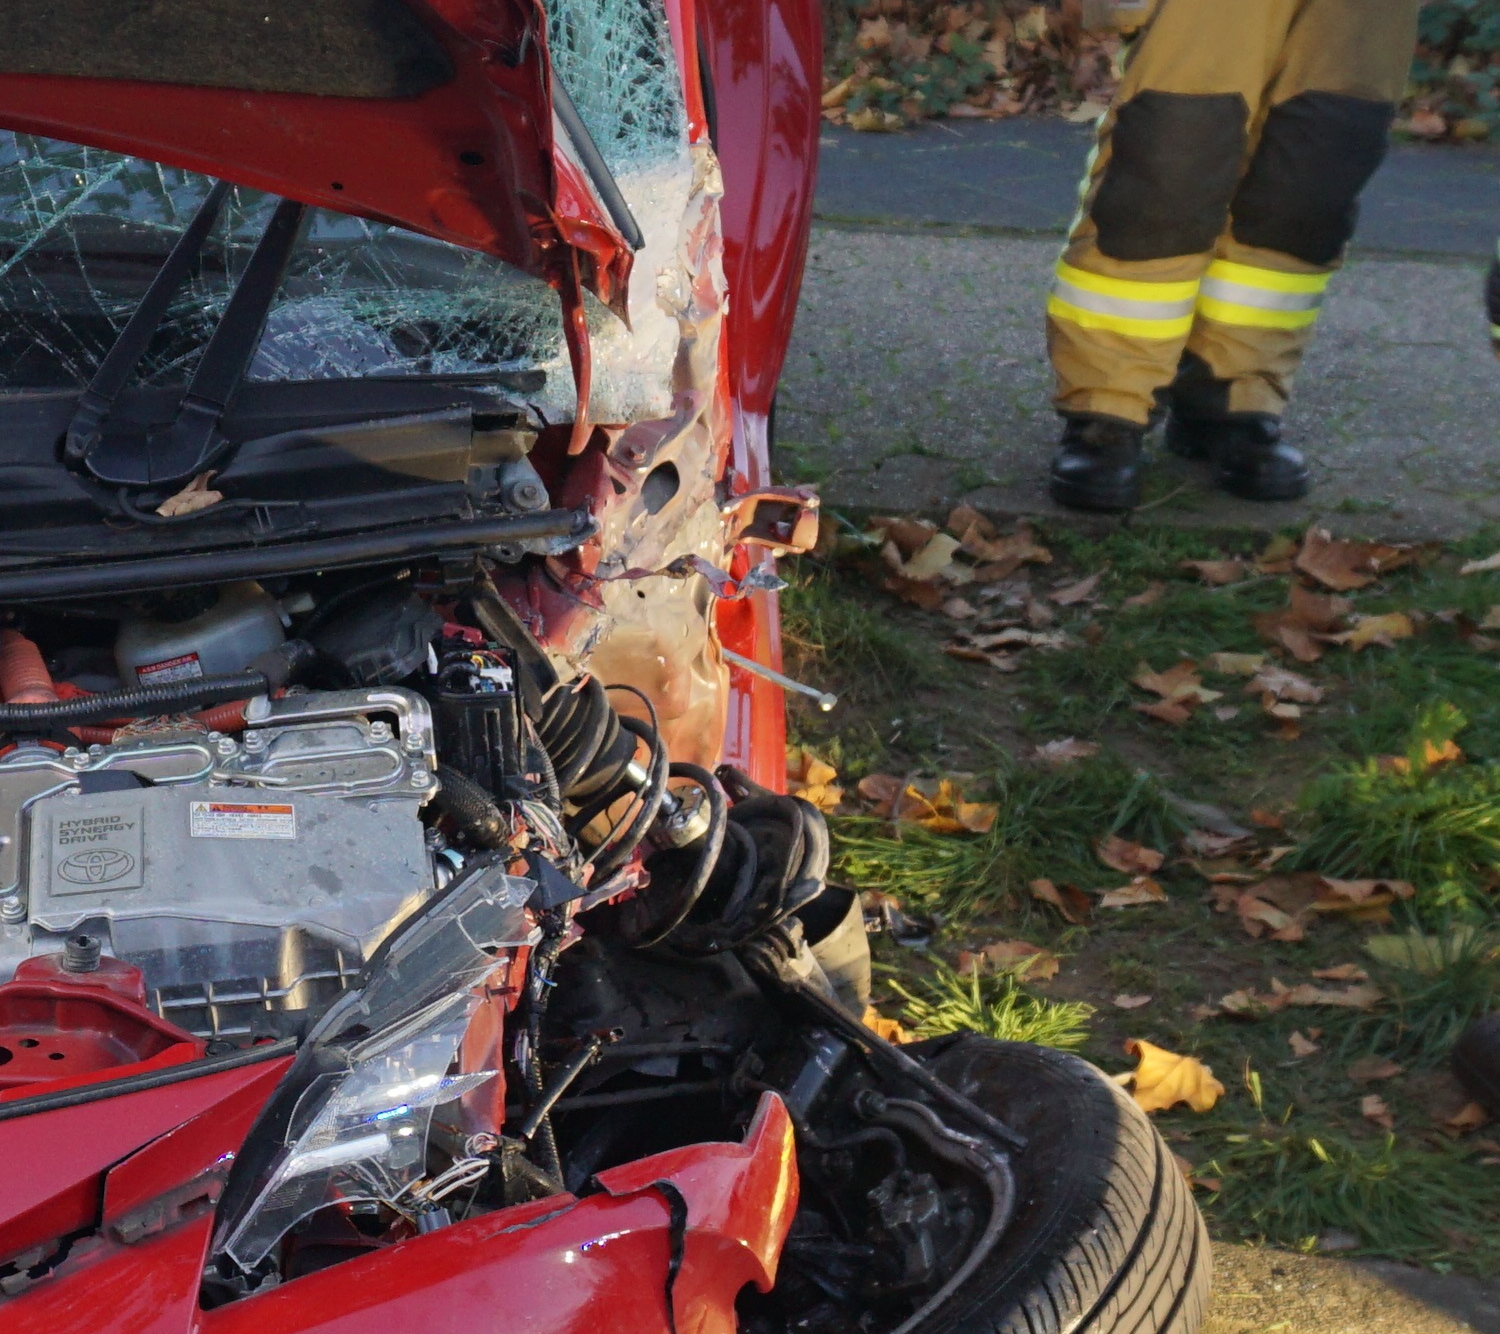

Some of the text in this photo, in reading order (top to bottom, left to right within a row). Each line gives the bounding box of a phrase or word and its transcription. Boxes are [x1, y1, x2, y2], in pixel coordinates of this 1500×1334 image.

[59, 815, 121, 829] HYBRID
[59, 822, 136, 837] SYNERGY
[59, 833, 109, 845] DRIVE
